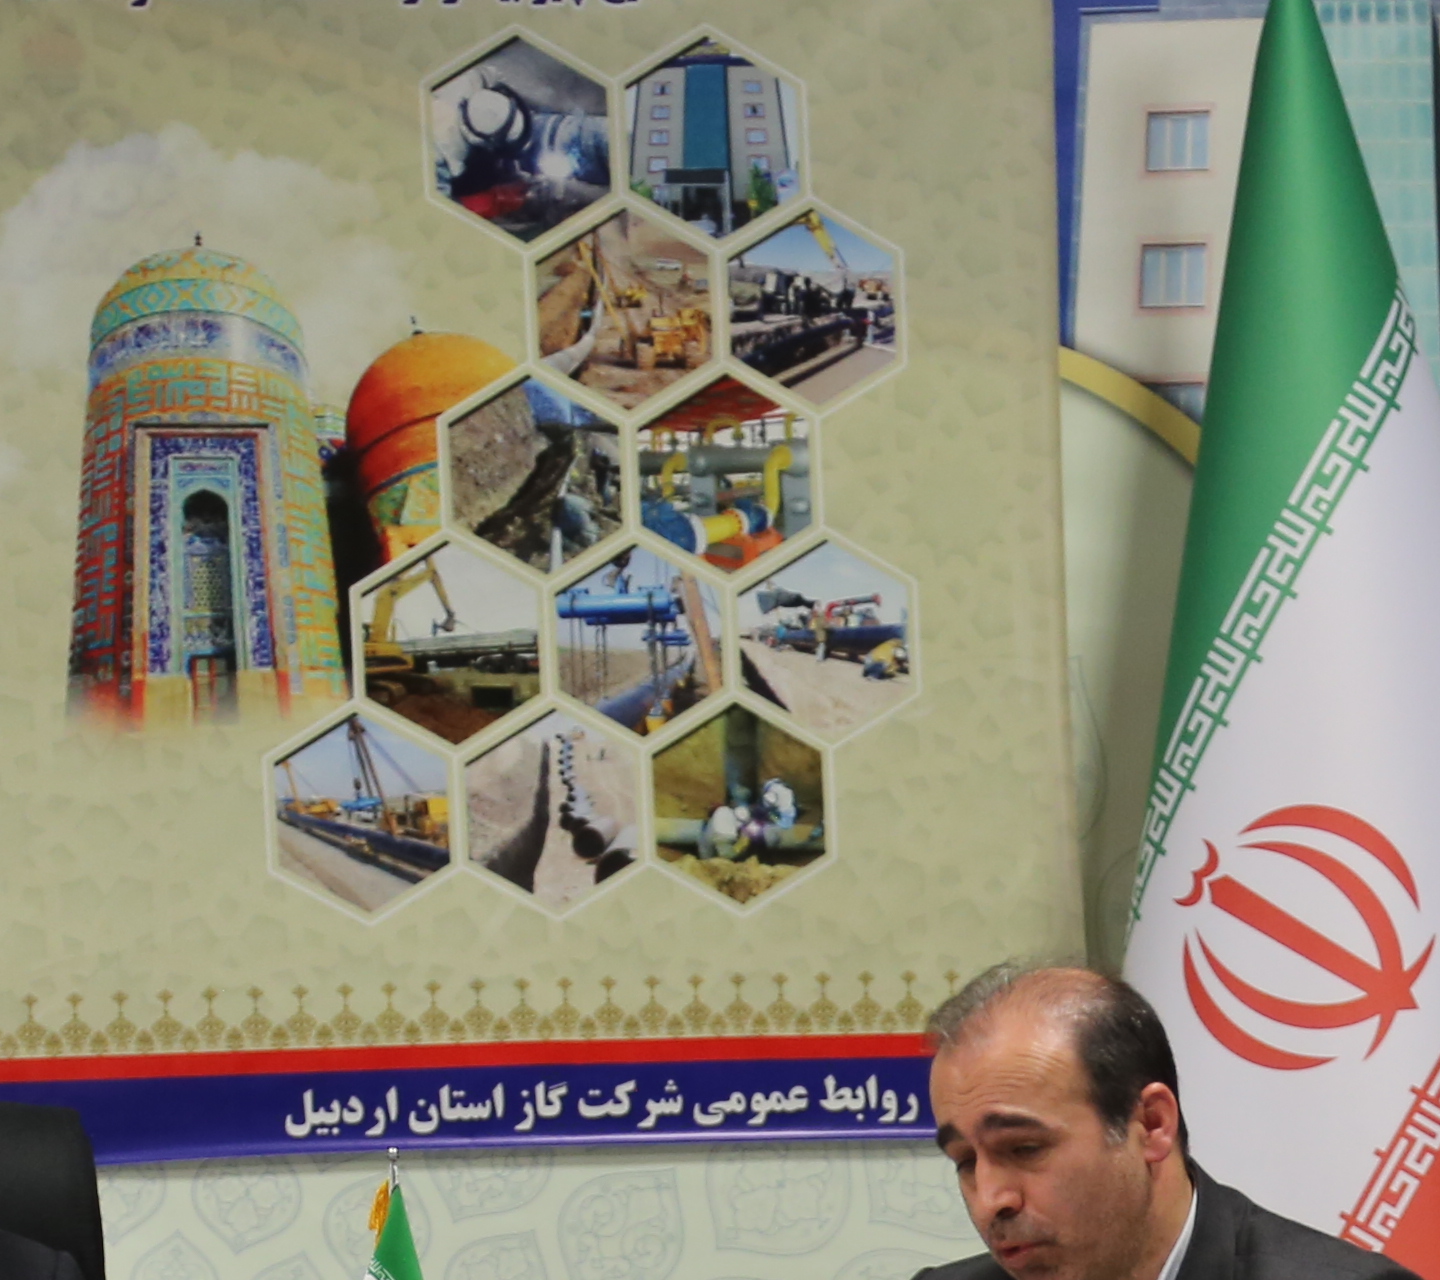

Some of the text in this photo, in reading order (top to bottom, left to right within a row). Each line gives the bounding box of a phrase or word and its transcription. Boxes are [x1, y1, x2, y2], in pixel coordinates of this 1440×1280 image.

[284, 1074, 920, 1138] روابط عمومی شرکت گاز استان اردبیل
